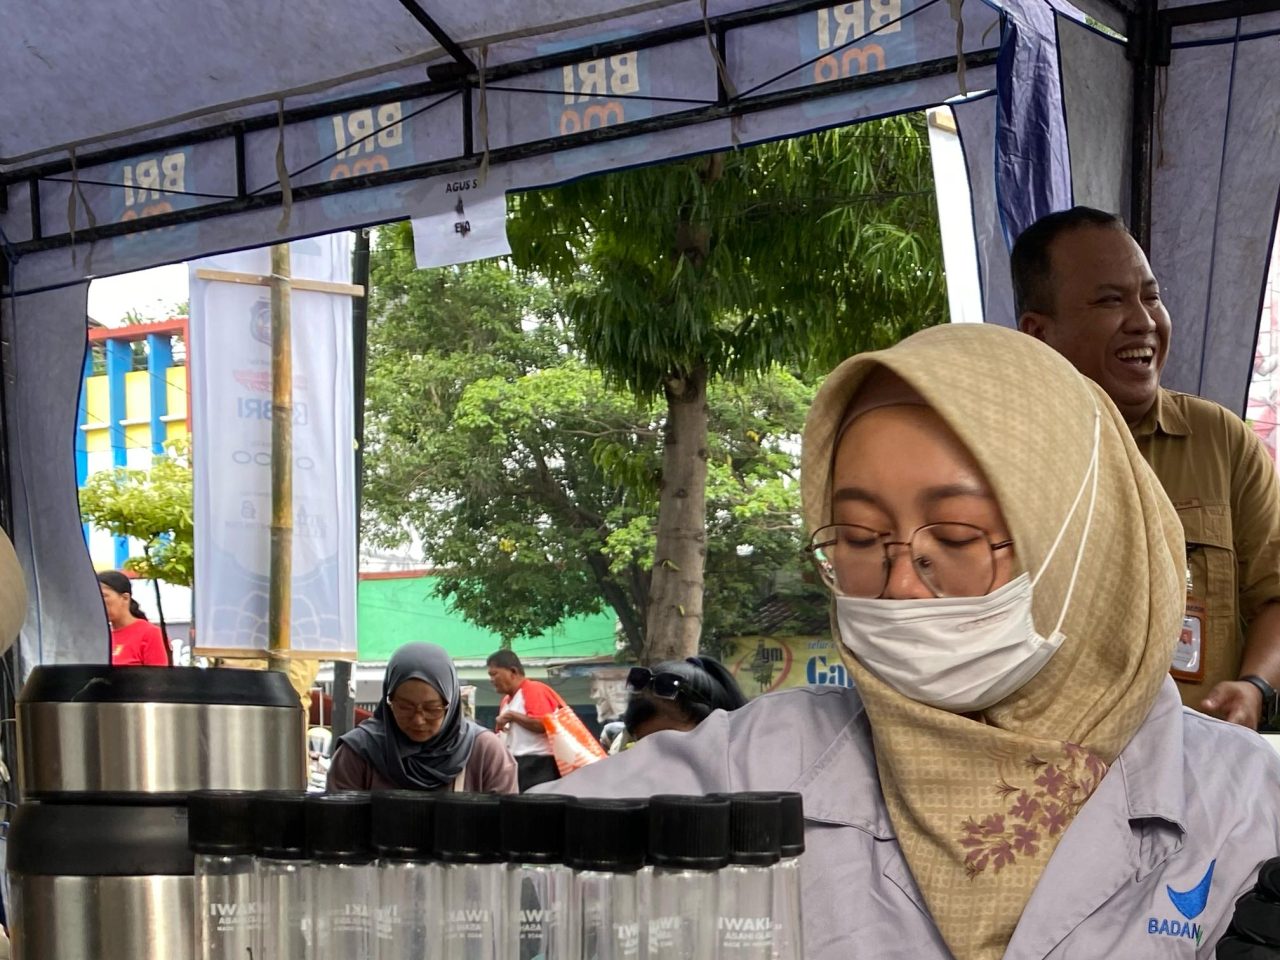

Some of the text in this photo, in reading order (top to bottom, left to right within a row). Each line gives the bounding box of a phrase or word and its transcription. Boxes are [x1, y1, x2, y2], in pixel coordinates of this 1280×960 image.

[446, 179, 478, 194] AGUS S
[719, 916, 770, 931] IWAKI
[1148, 918, 1202, 940] BADAN
